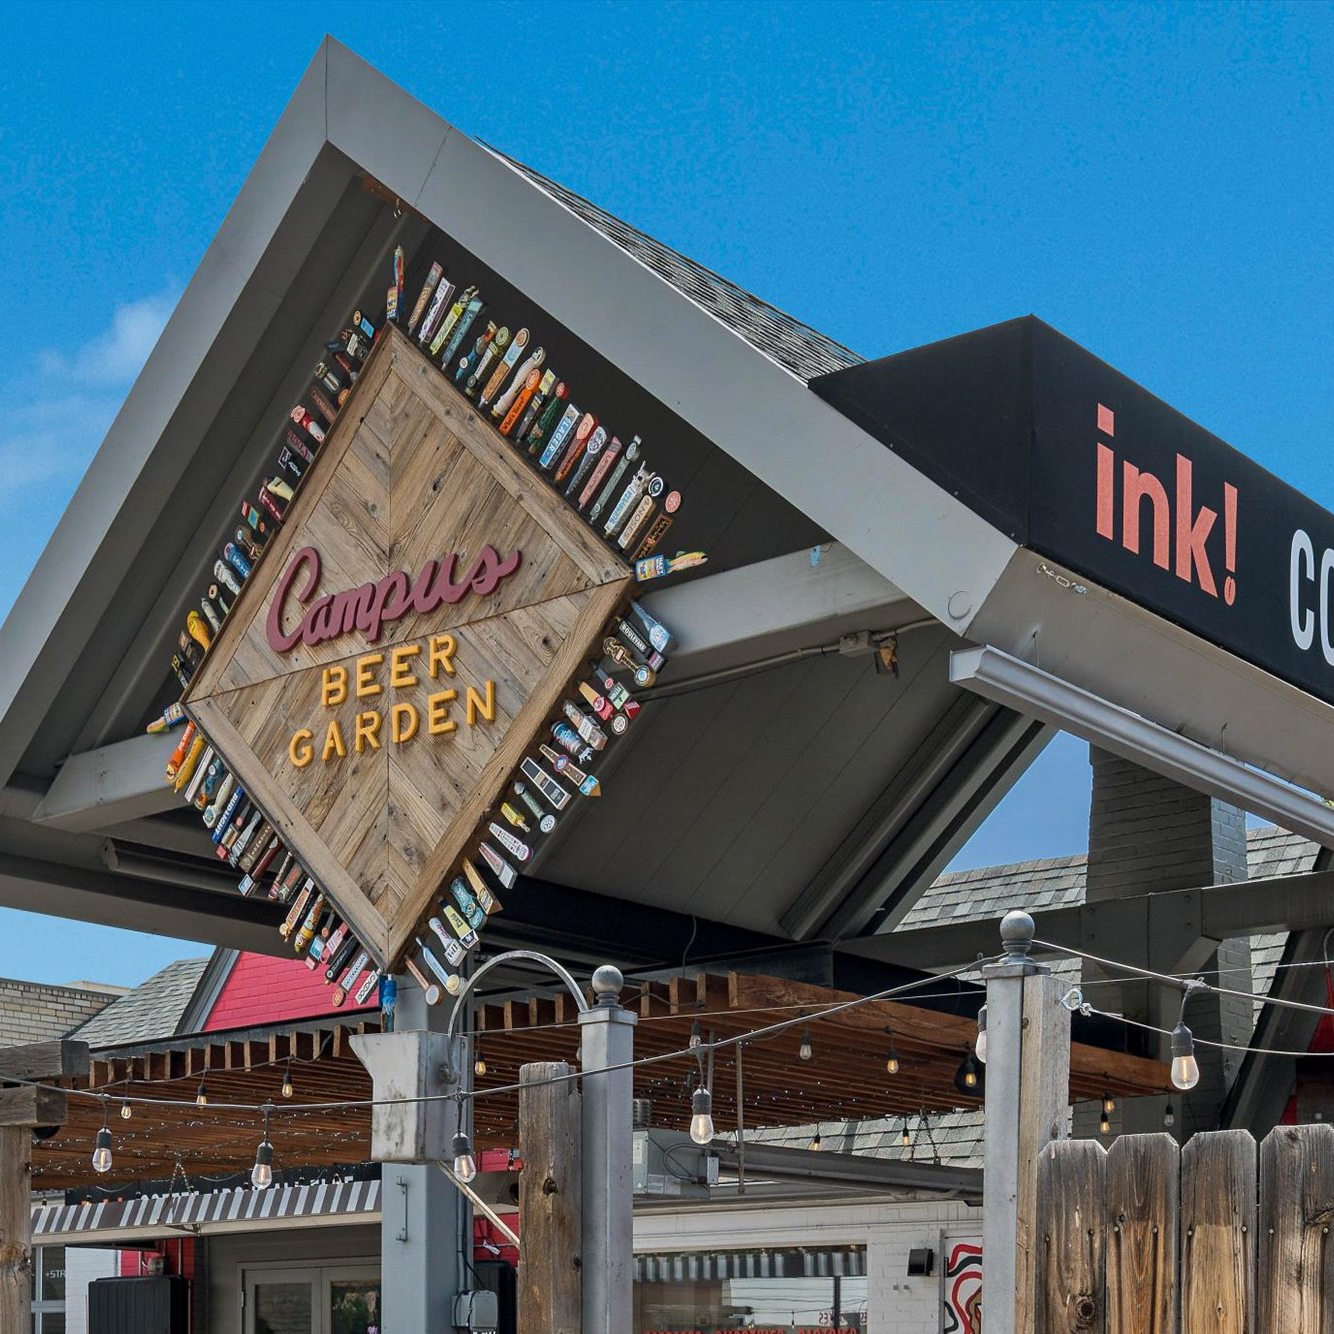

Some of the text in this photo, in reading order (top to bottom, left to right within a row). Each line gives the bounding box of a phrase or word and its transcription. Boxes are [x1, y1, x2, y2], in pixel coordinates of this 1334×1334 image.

[546, 420, 570, 452] LAGER
[621, 504, 646, 538] NOSES
[1096, 402, 1239, 606] ink!
[266, 544, 522, 652] Campus
[618, 623, 647, 650] BOULEVARD
[321, 635, 457, 707] BEER
[289, 680, 495, 768] GARDEN
[211, 792, 240, 835] BUD LIGHT
